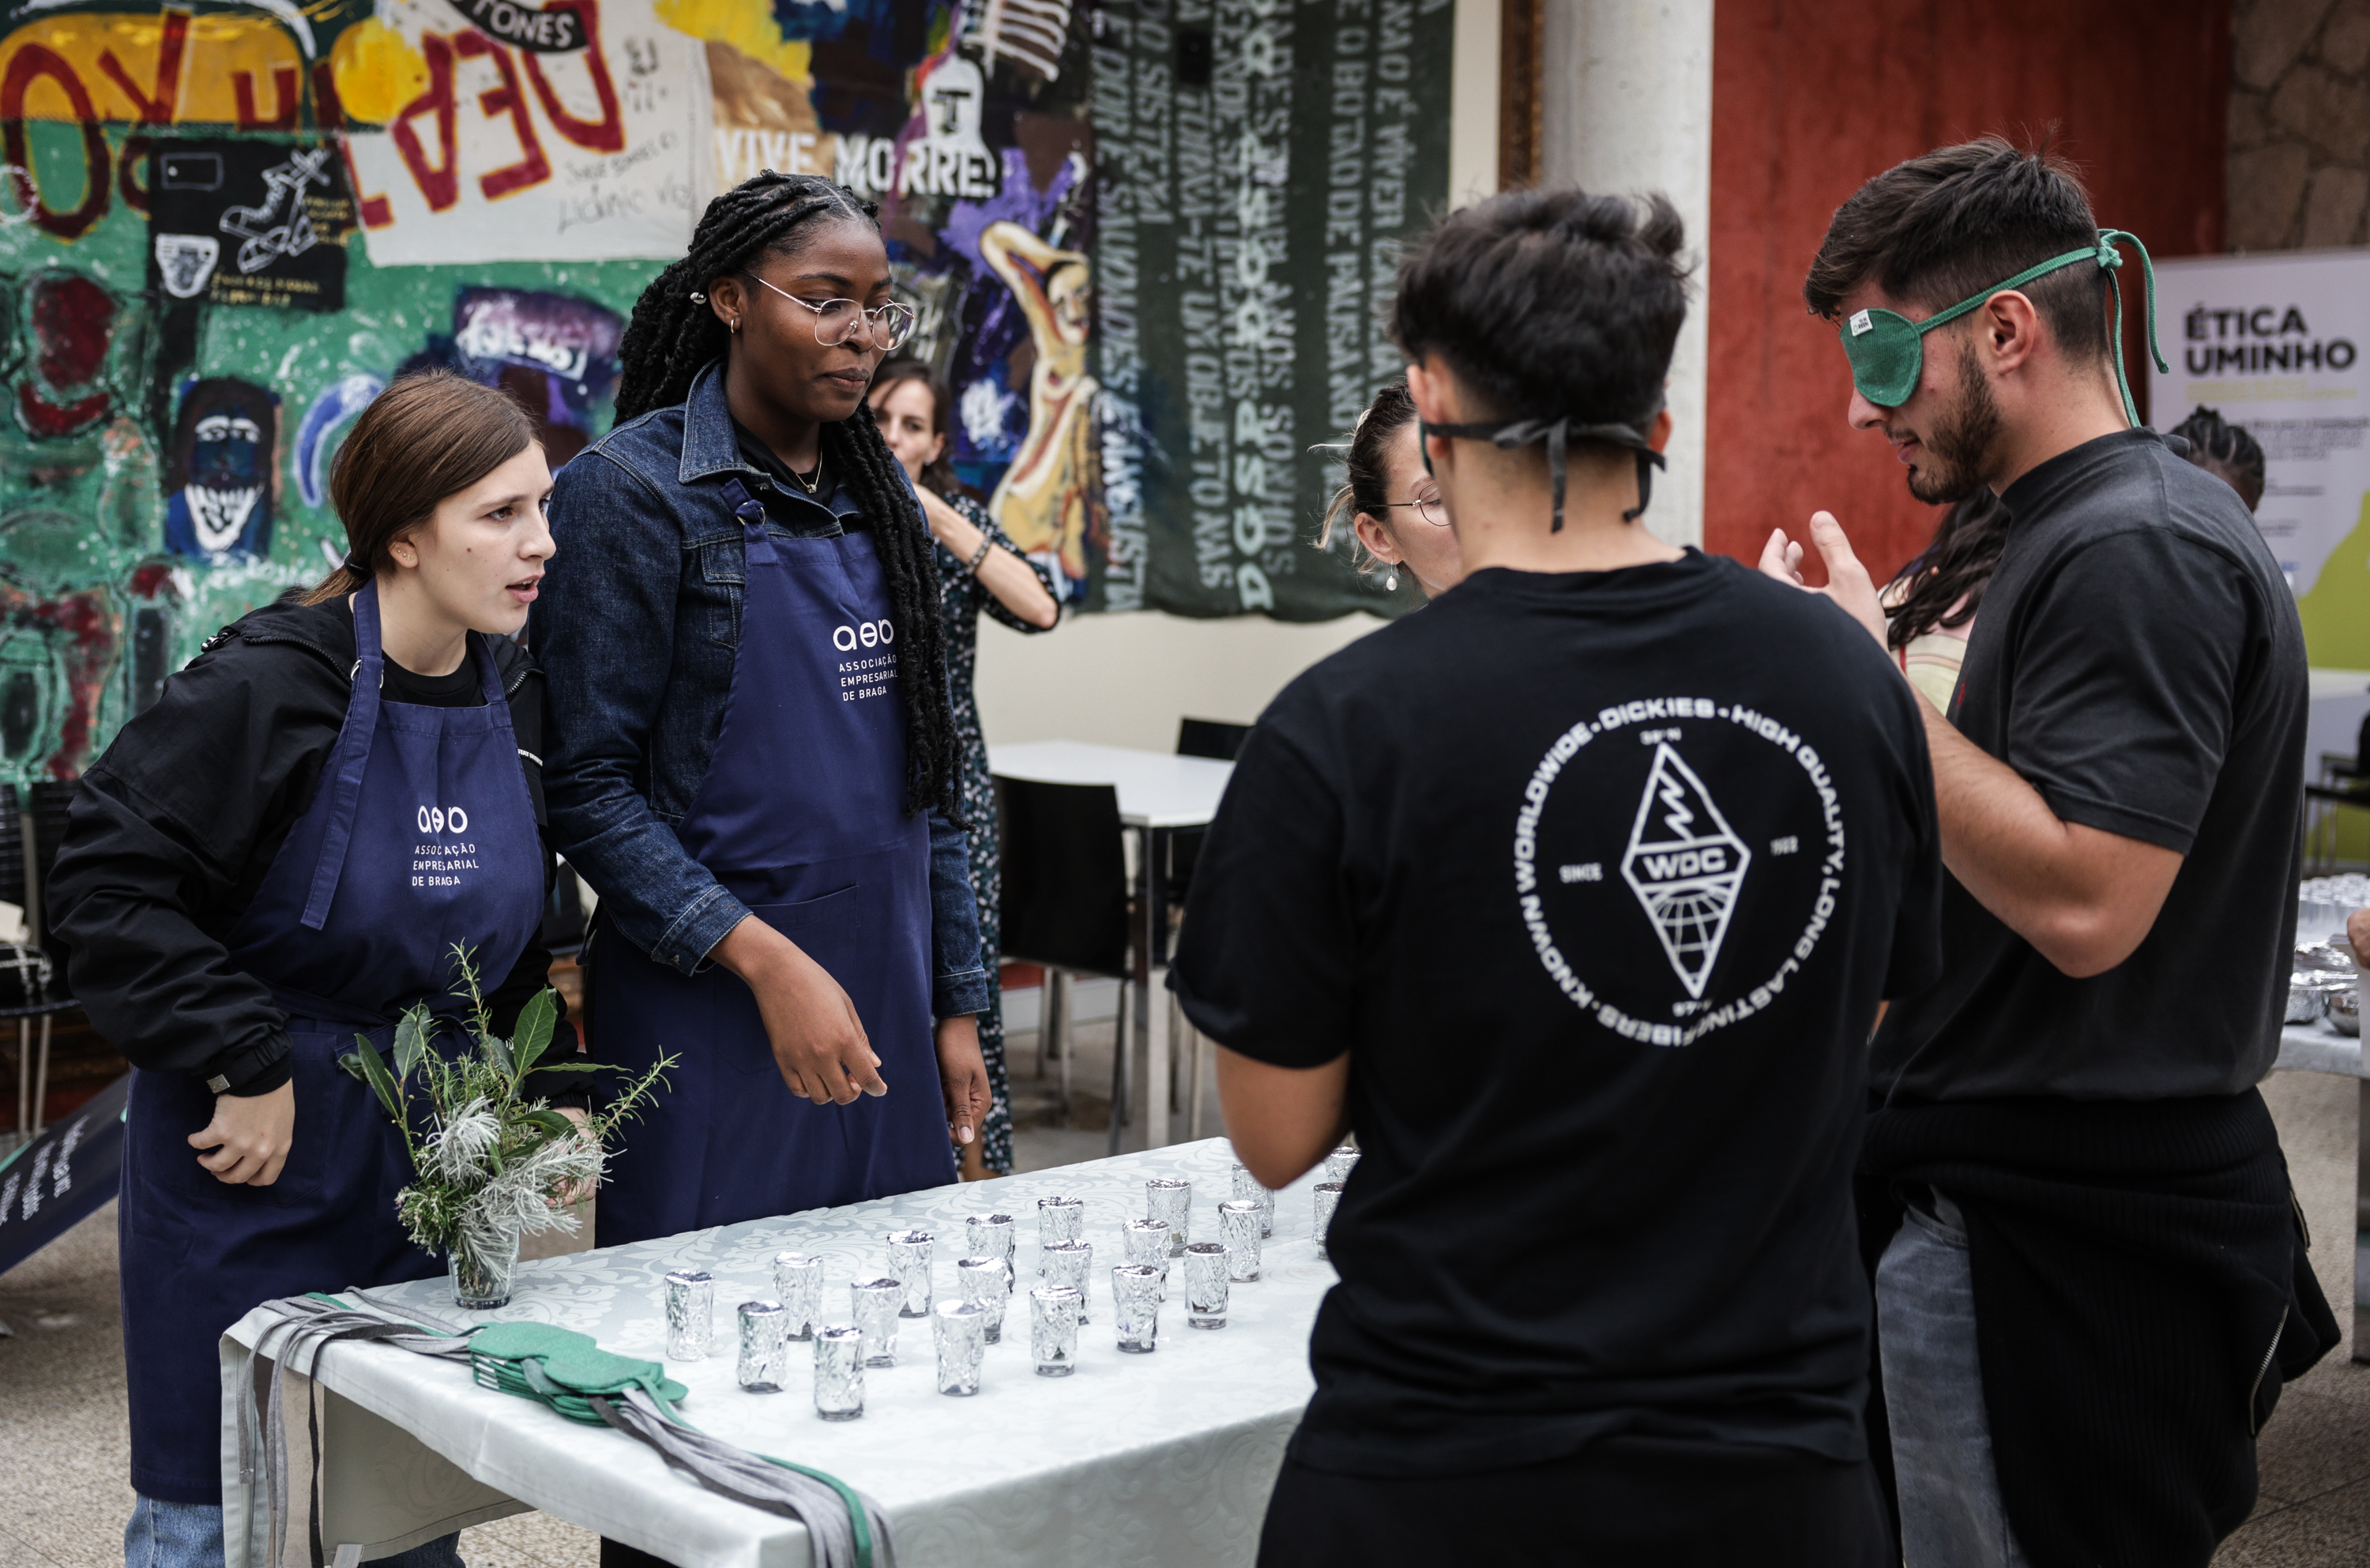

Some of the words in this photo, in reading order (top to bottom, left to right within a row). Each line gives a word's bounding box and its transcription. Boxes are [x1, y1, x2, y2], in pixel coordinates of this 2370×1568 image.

[452, 0, 575, 49] TONES
[1090, 45, 1135, 137] DOR
[716, 127, 817, 182] VIVE
[1326, 190, 1364, 245] DE
[2184, 302, 2308, 342] ÉTICA
[2184, 337, 2357, 377] UMINHO
[1184, 352, 1231, 508] OBJETO
[1233, 399, 1275, 611] DGSP
[1259, 402, 1297, 576] SONHOS
[839, 654, 897, 672] ASSOCIAÇÃO
[841, 669, 899, 687] EMPRESARIAL
[842, 691, 856, 701] DE
[859, 686, 887, 699] BRAGA
[1597, 697, 1716, 731] DICKIES
[1730, 704, 1801, 754] HIGH
[1513, 720, 1597, 893] WORLDWIDE
[412, 859, 480, 871] EMPRESARIAL
[412, 876, 424, 886] DE
[429, 875, 461, 886] BRAGA
[1559, 862, 1604, 884] SINCE
[1642, 847, 1728, 882] WDC
[1793, 877, 1841, 961] LONG
[1518, 893, 1597, 1011] KNOWN
